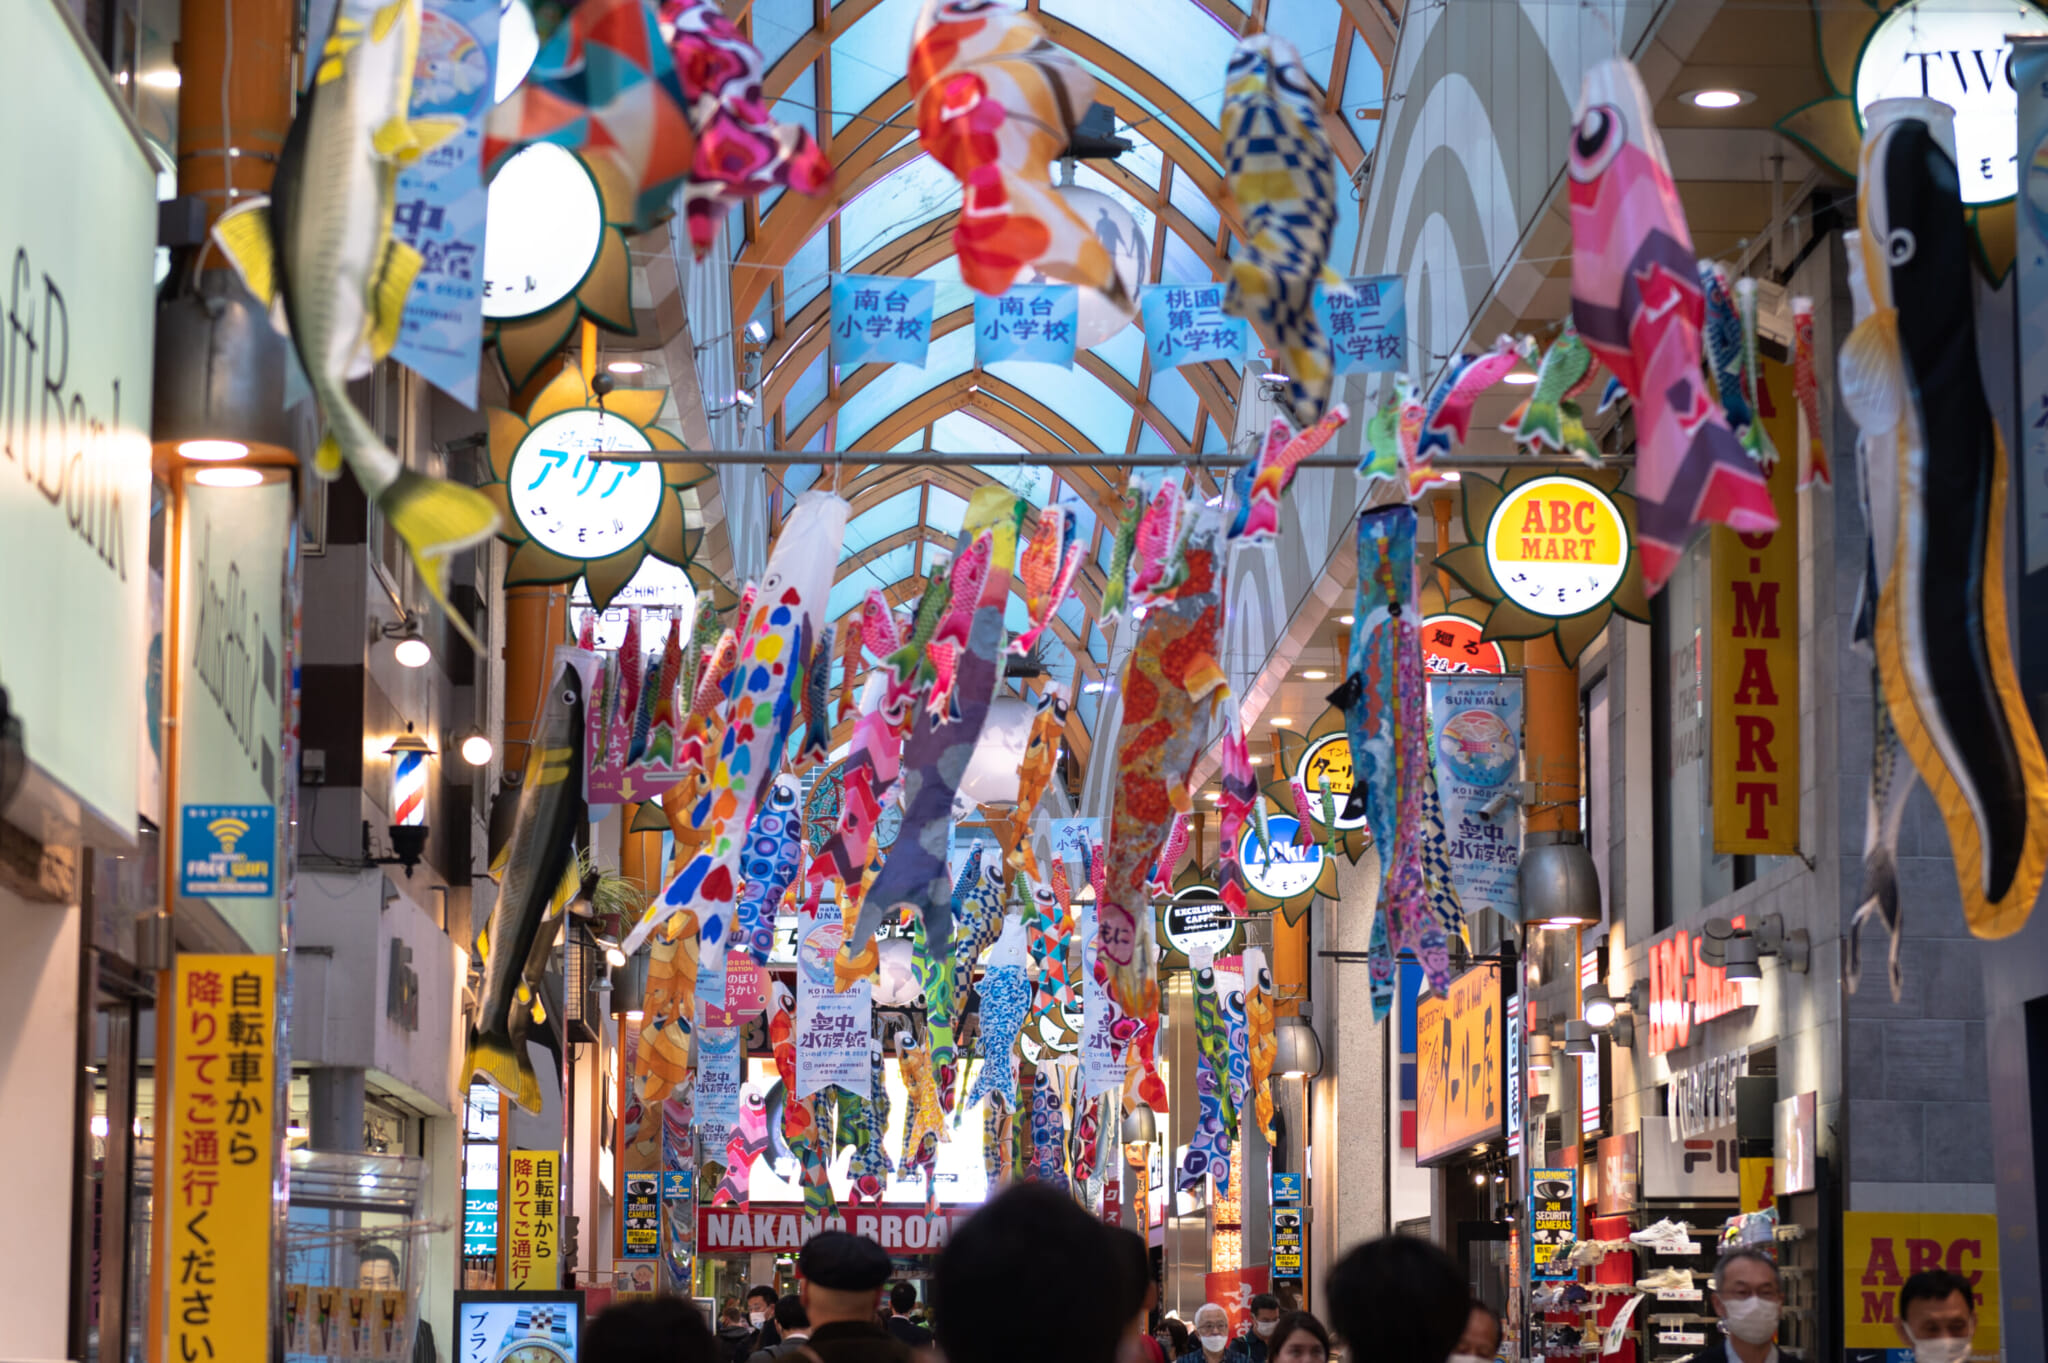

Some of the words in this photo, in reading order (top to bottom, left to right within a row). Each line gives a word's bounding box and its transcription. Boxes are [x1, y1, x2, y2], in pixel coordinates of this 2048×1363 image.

[854, 289, 909, 312] 南台
[998, 296, 1054, 317] 南台
[1166, 289, 1221, 308] 桃園
[837, 315, 922, 342] 小学校
[984, 320, 1070, 344] 小学校
[1168, 310, 1223, 331] 第二
[1331, 311, 1385, 336] 第二
[1157, 329, 1239, 357] 小学校
[528, 448, 641, 499] アリア
[1521, 500, 1596, 535] ABC
[1521, 538, 1597, 561] MART
[1511, 573, 1599, 602] サンモール
[1432, 629, 1480, 655] 廻る
[1445, 695, 1472, 705] SUN
[1475, 697, 1508, 707] MALL
[1458, 817, 1504, 843] 空中
[1449, 840, 1517, 866] 水族館
[728, 974, 758, 984] のぼり
[728, 985, 757, 995] うかい
[811, 1012, 855, 1031] 空中
[799, 1031, 868, 1049] 水族館
[226, 971, 264, 1166] 自転車から
[179, 970, 223, 1363] 降りてご通行ください
[534, 1158, 554, 1259] 自転車から
[628, 1203, 656, 1211] SECURITY
[628, 1211, 657, 1219] CAMERAS
[1536, 1210, 1571, 1221] SECURITY
[1546, 1201, 1561, 1211] 24H
[707, 1214, 847, 1248] NAKANO
[856, 1215, 962, 1249] BROA
[1536, 1220, 1572, 1230] CAMERAS
[1860, 1237, 1984, 1287] ABC
